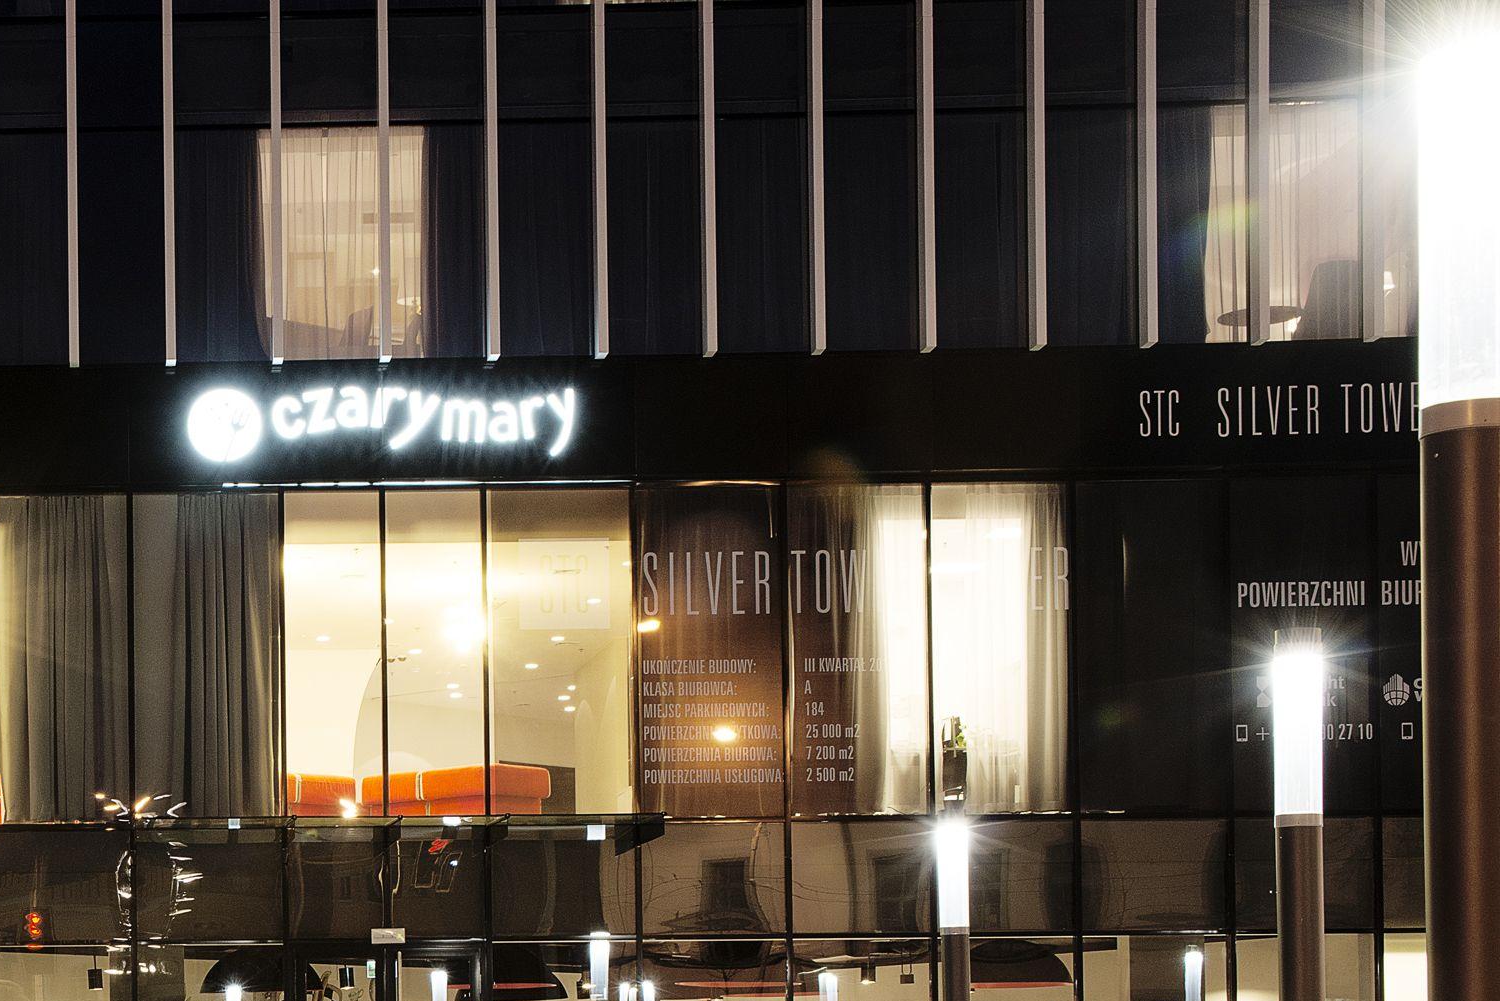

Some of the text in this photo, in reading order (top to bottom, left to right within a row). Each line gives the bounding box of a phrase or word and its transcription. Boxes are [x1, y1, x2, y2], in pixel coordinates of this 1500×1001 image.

[1139, 381, 1420, 438] STC SILVER TOWE
[642, 550, 771, 616] SILVER
[1237, 580, 1365, 608] POWIERZCHNI
[642, 656, 705, 675] UKOŃCZENIE
[708, 658, 757, 674] BUDOWY:
[804, 657, 816, 673] III
[643, 679, 812, 697] KLASA BIUROWCA: A
[643, 701, 825, 719] MIEJSC PARKINGOWYCH: 184
[643, 725, 717, 741] POWIERZCHNI
[805, 723, 819, 739] 25
[822, 723, 842, 739] 000
[845, 723, 861, 739] m2
[1338, 723, 1353, 740] 27
[1358, 723, 1373, 740] 10
[644, 745, 854, 763] POWIERZCHNIA BIUROWA: 7 200 m2
[644, 767, 855, 784] POWIERZCHNIA USŁUGOWA: 2 500 m2
